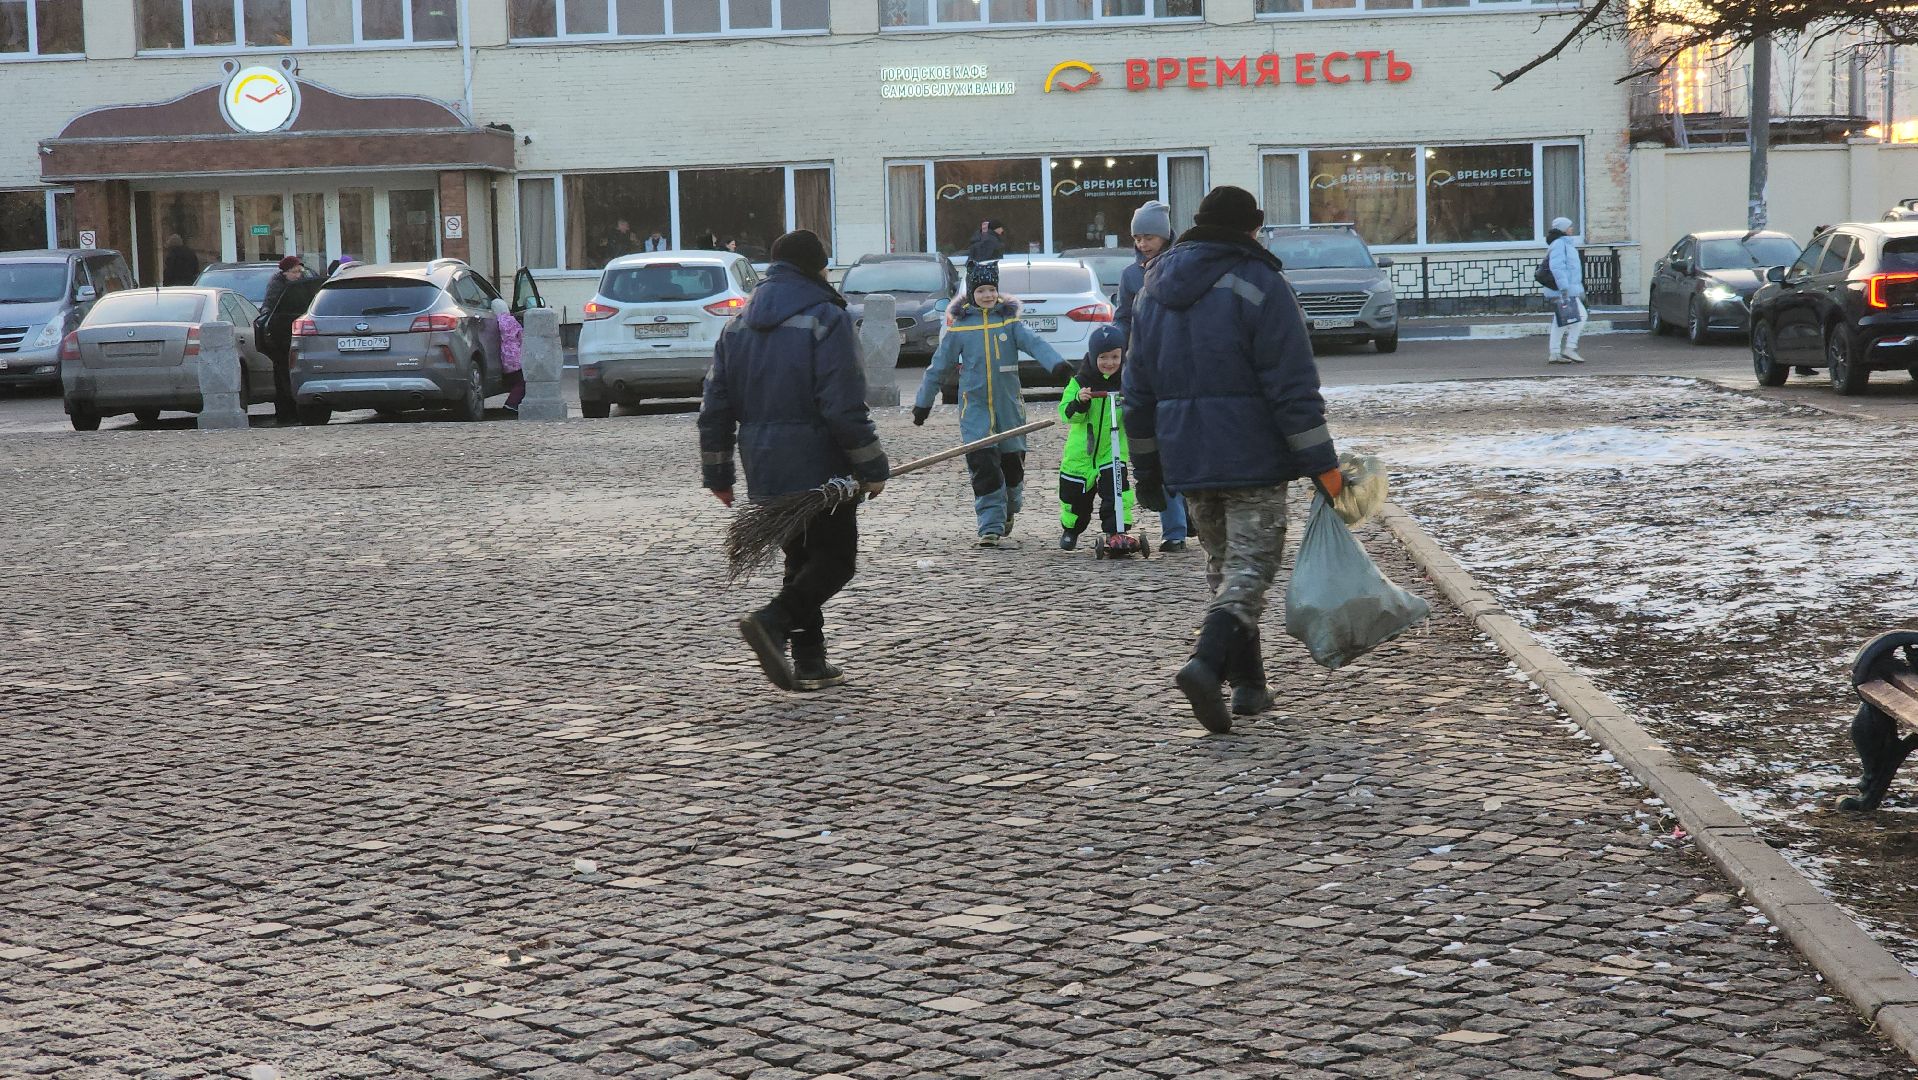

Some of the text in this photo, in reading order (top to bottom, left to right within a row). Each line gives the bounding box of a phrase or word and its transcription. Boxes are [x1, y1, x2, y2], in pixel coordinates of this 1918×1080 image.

[881, 64, 988, 81] ГОРОДСКОЕ КАФЕ
[1125, 50, 1412, 91] ВРЕМЯ ЕСТЬ
[881, 81, 1015, 98] САМООБСЛУЖИВАНИЯ
[1341, 172, 1415, 183] ВРЕМЯ ЕСТЬ
[1457, 168, 1532, 180] ВРЕМЯ ЕСТЬ
[966, 182, 1041, 193] ВРЕМЯ ЕСТЬ
[1083, 179, 1158, 190] ВРЕМЯ ЕСТЬ
